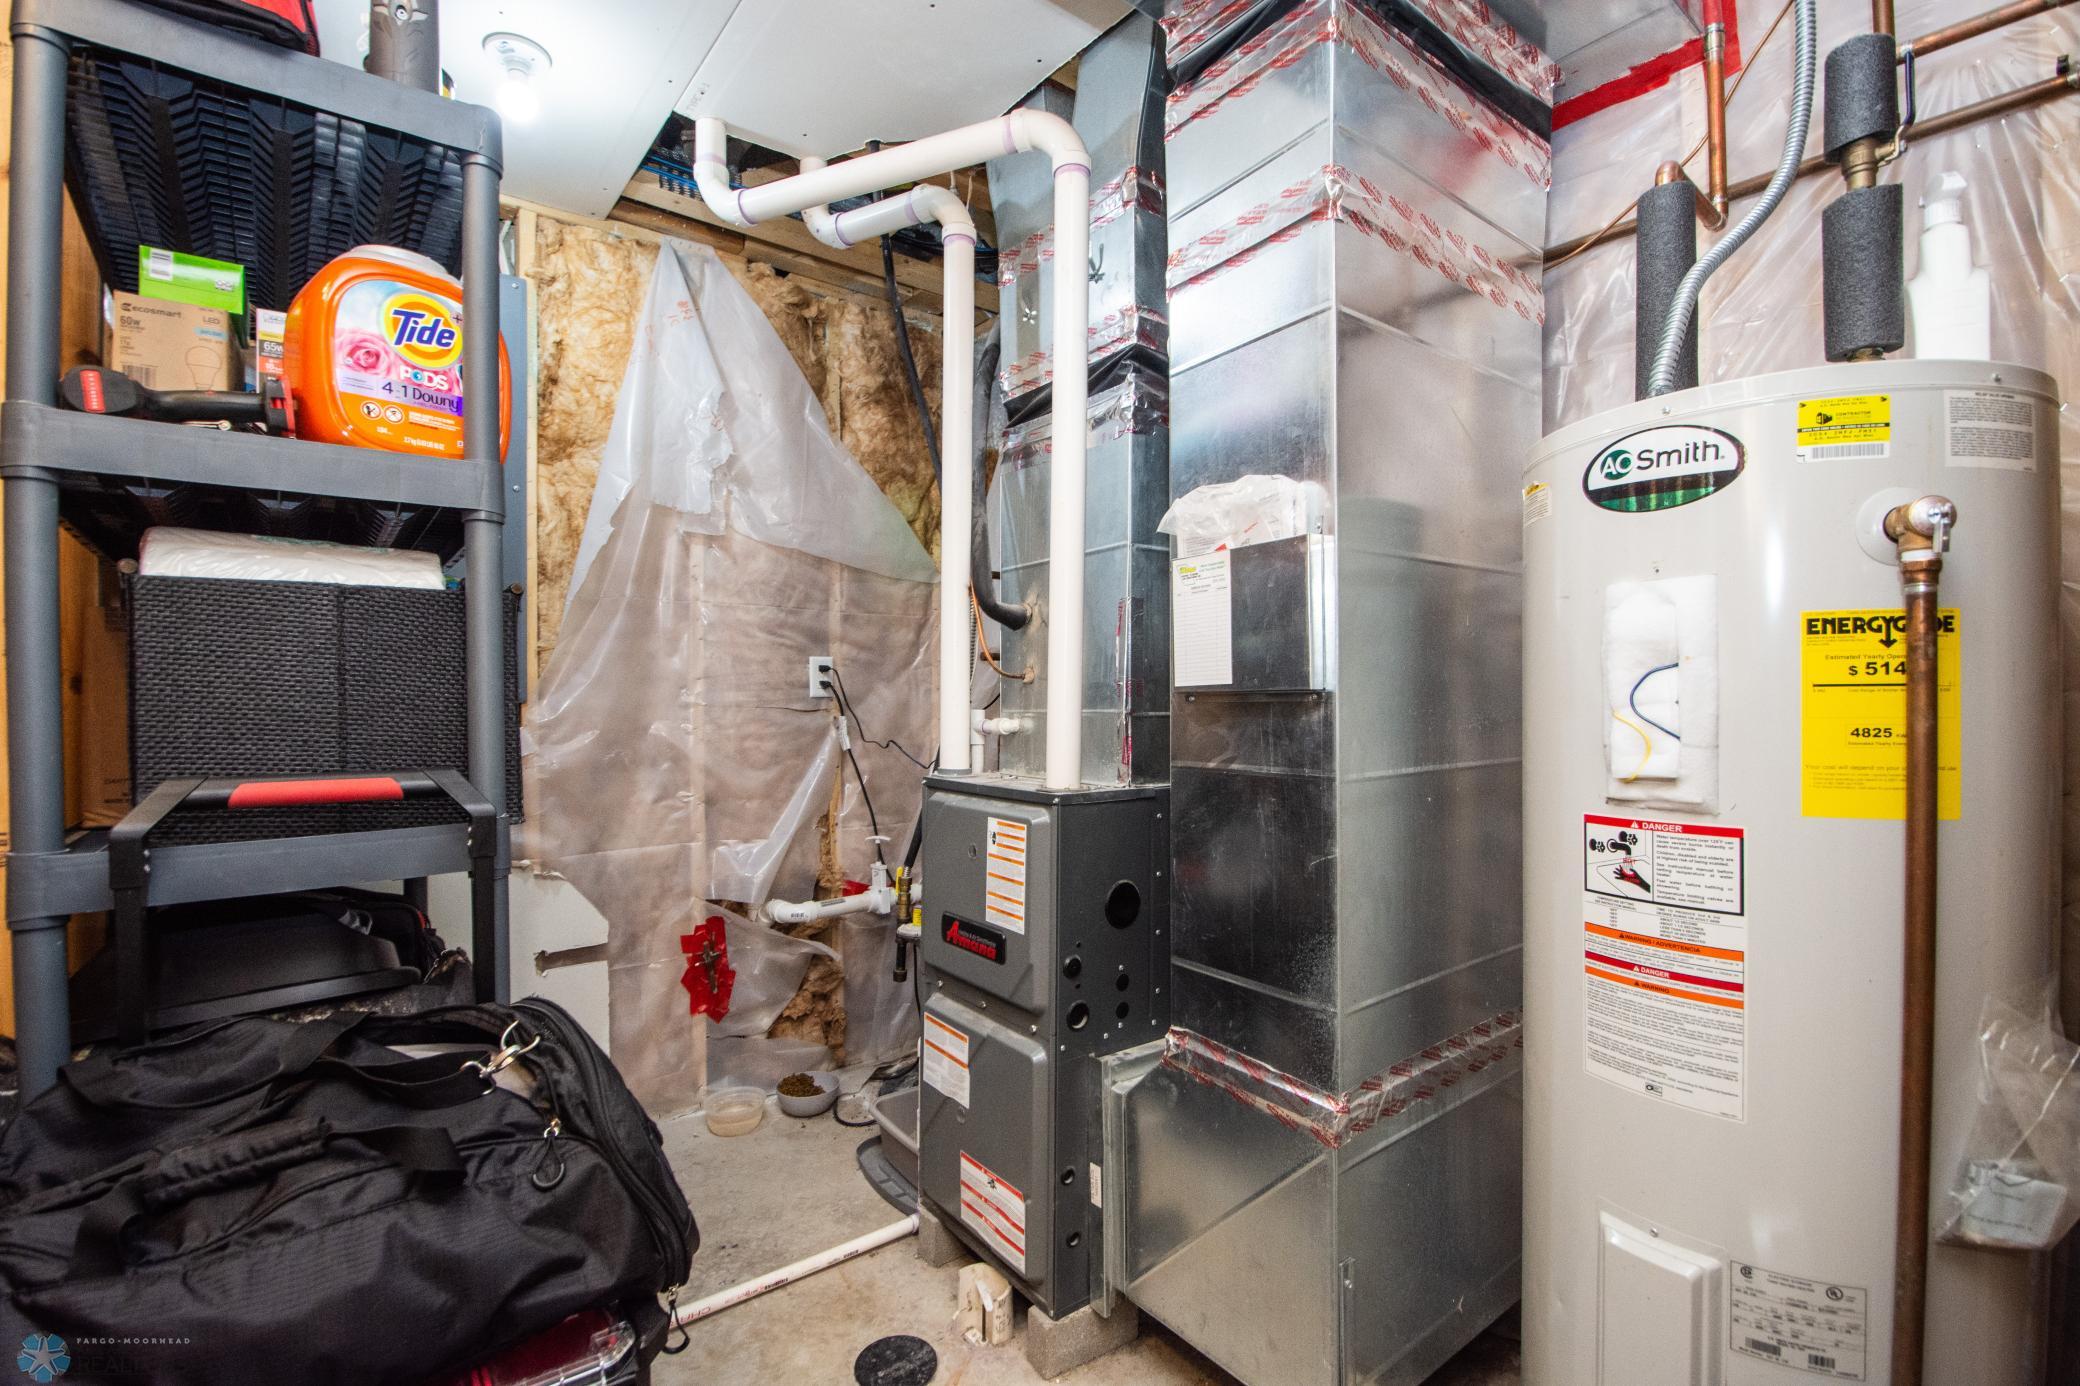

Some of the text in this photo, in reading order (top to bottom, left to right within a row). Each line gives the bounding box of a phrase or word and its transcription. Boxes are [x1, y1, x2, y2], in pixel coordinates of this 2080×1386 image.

[392, 309, 455, 348] Tide
[400, 365, 449, 390] PODS
[413, 388, 460, 413] Downy
[1865, 662, 1906, 675] 514
[1850, 728, 1893, 738] 4825
[1642, 823, 1683, 833] DANGER
[946, 920, 996, 960] Amana
[1640, 967, 1670, 979] DANGER
